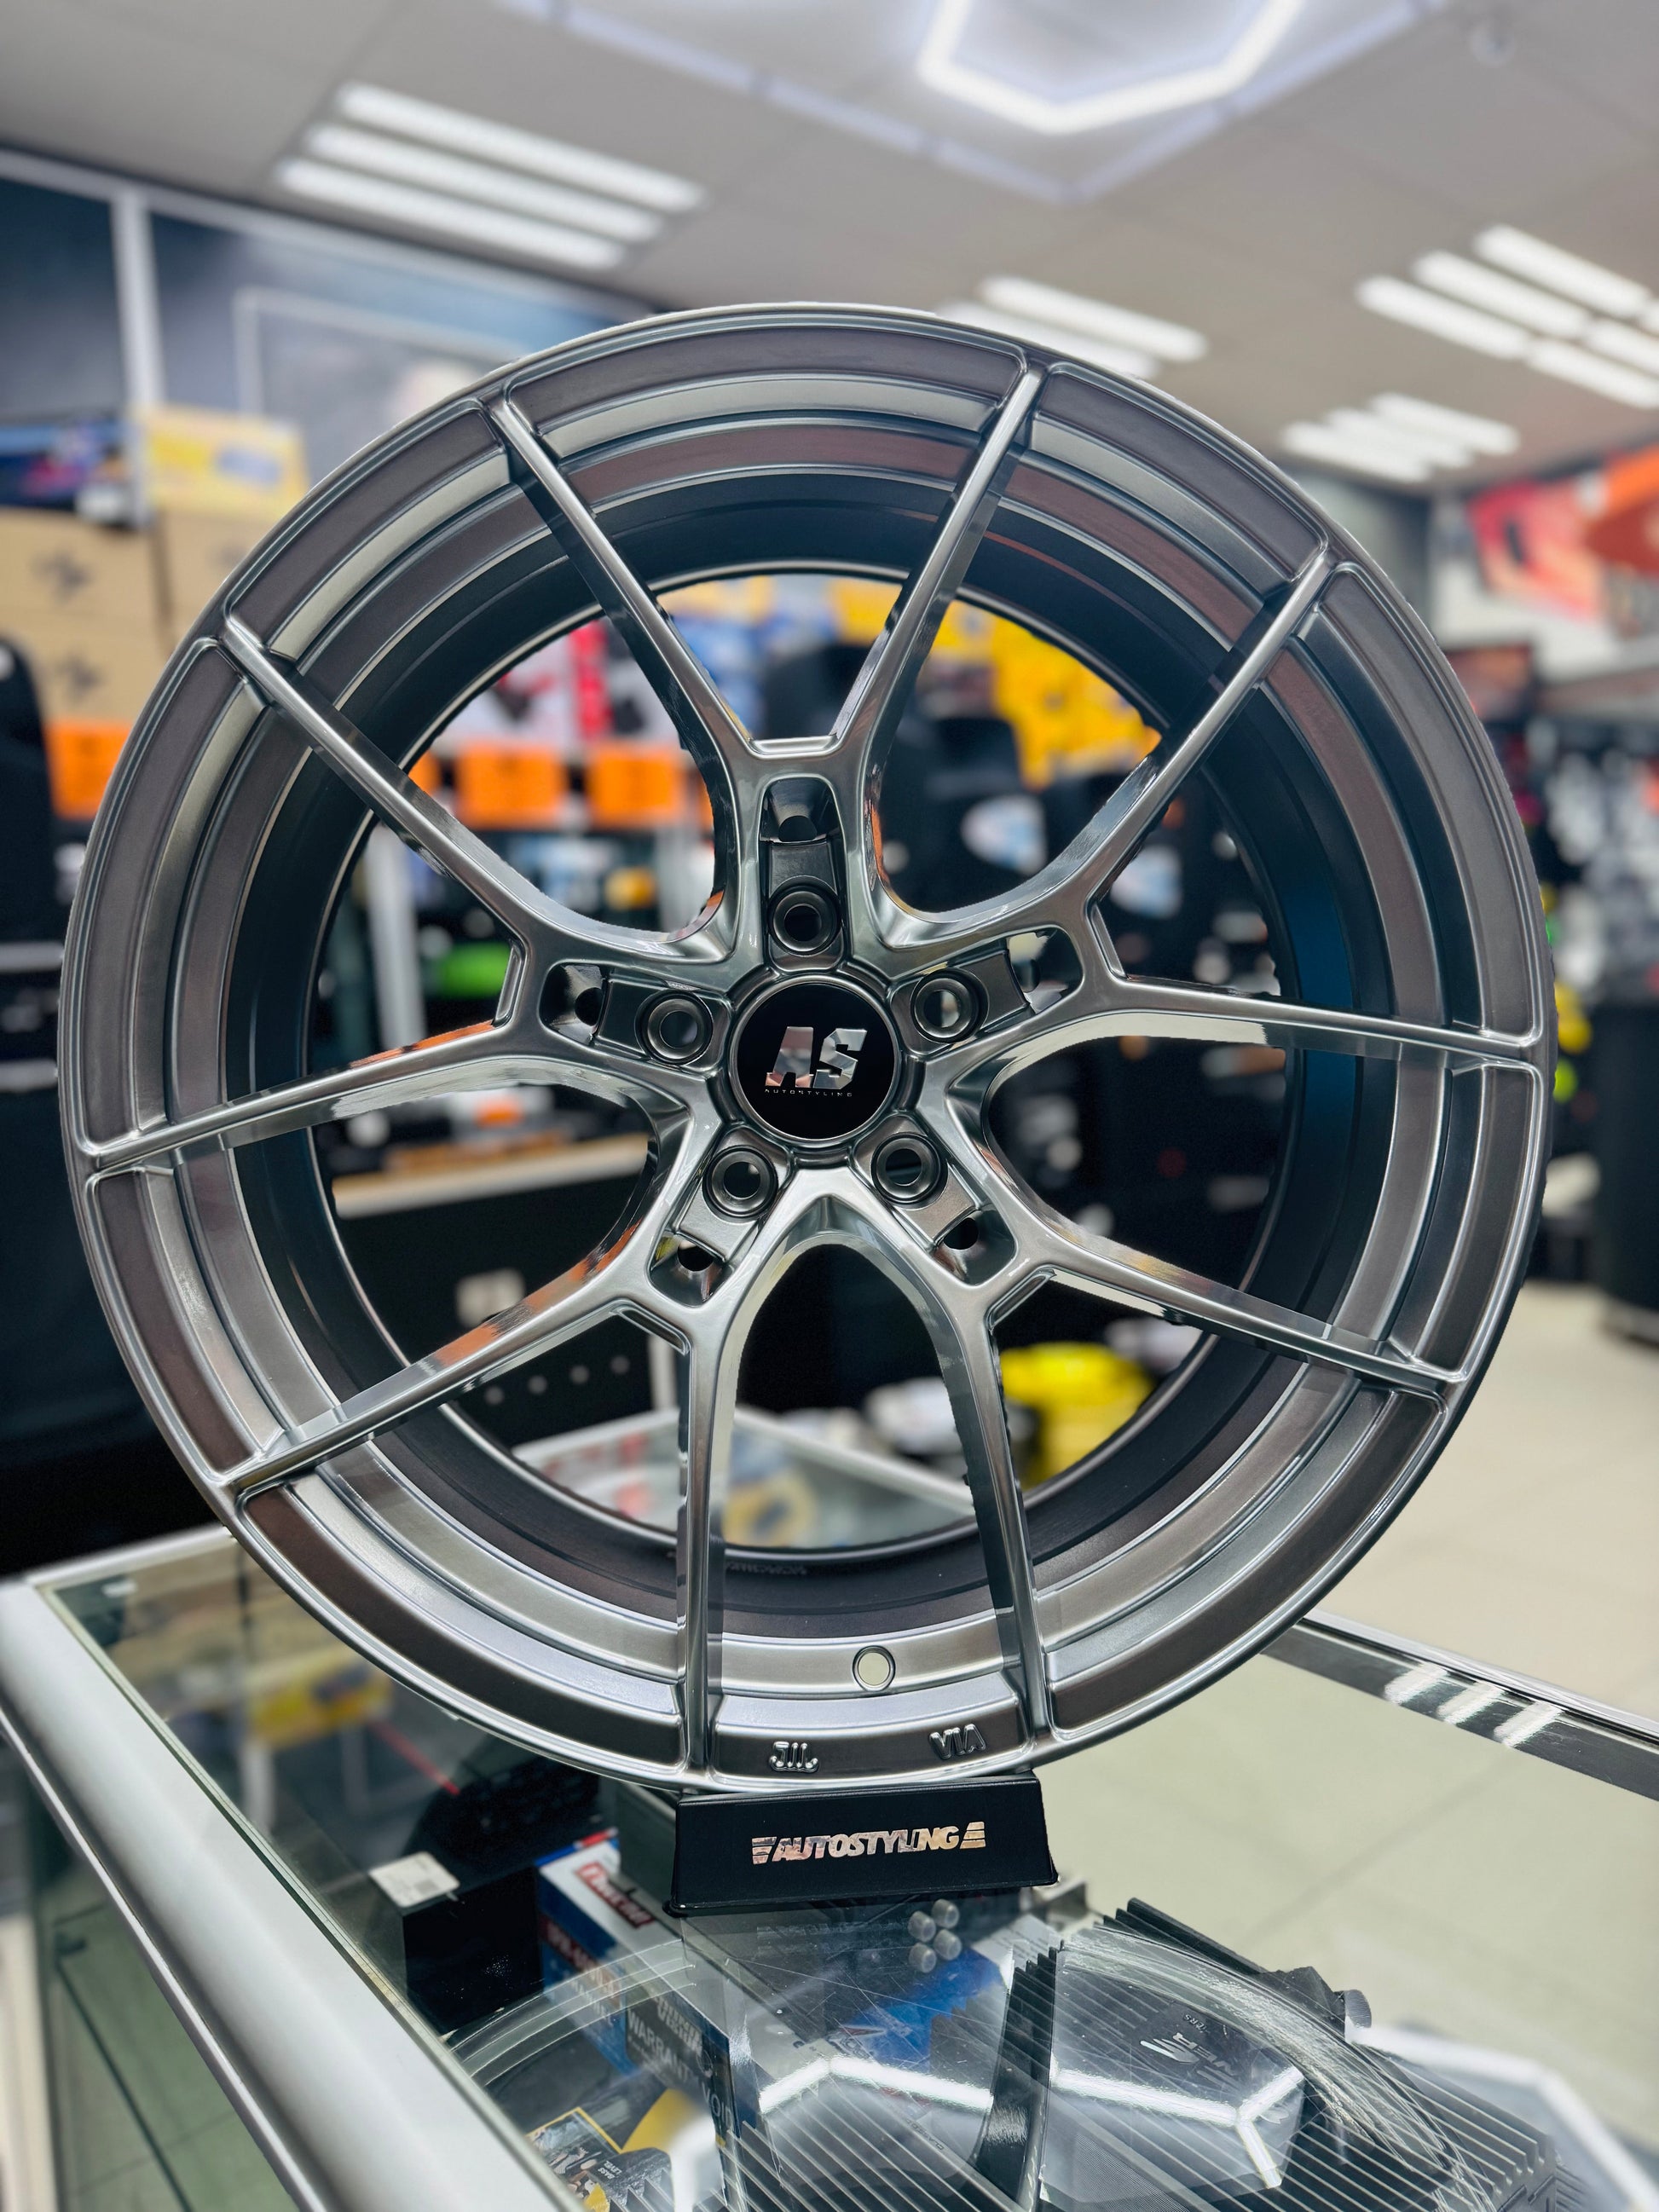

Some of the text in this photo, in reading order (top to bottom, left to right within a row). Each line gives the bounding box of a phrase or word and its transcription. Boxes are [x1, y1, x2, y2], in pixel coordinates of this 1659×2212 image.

[765, 1025, 868, 1090] AS
[764, 1089, 853, 1097] AUTOSTYLING
[928, 1723, 986, 1759] VIA
[772, 1825, 960, 1863] AUTOSTYLING
